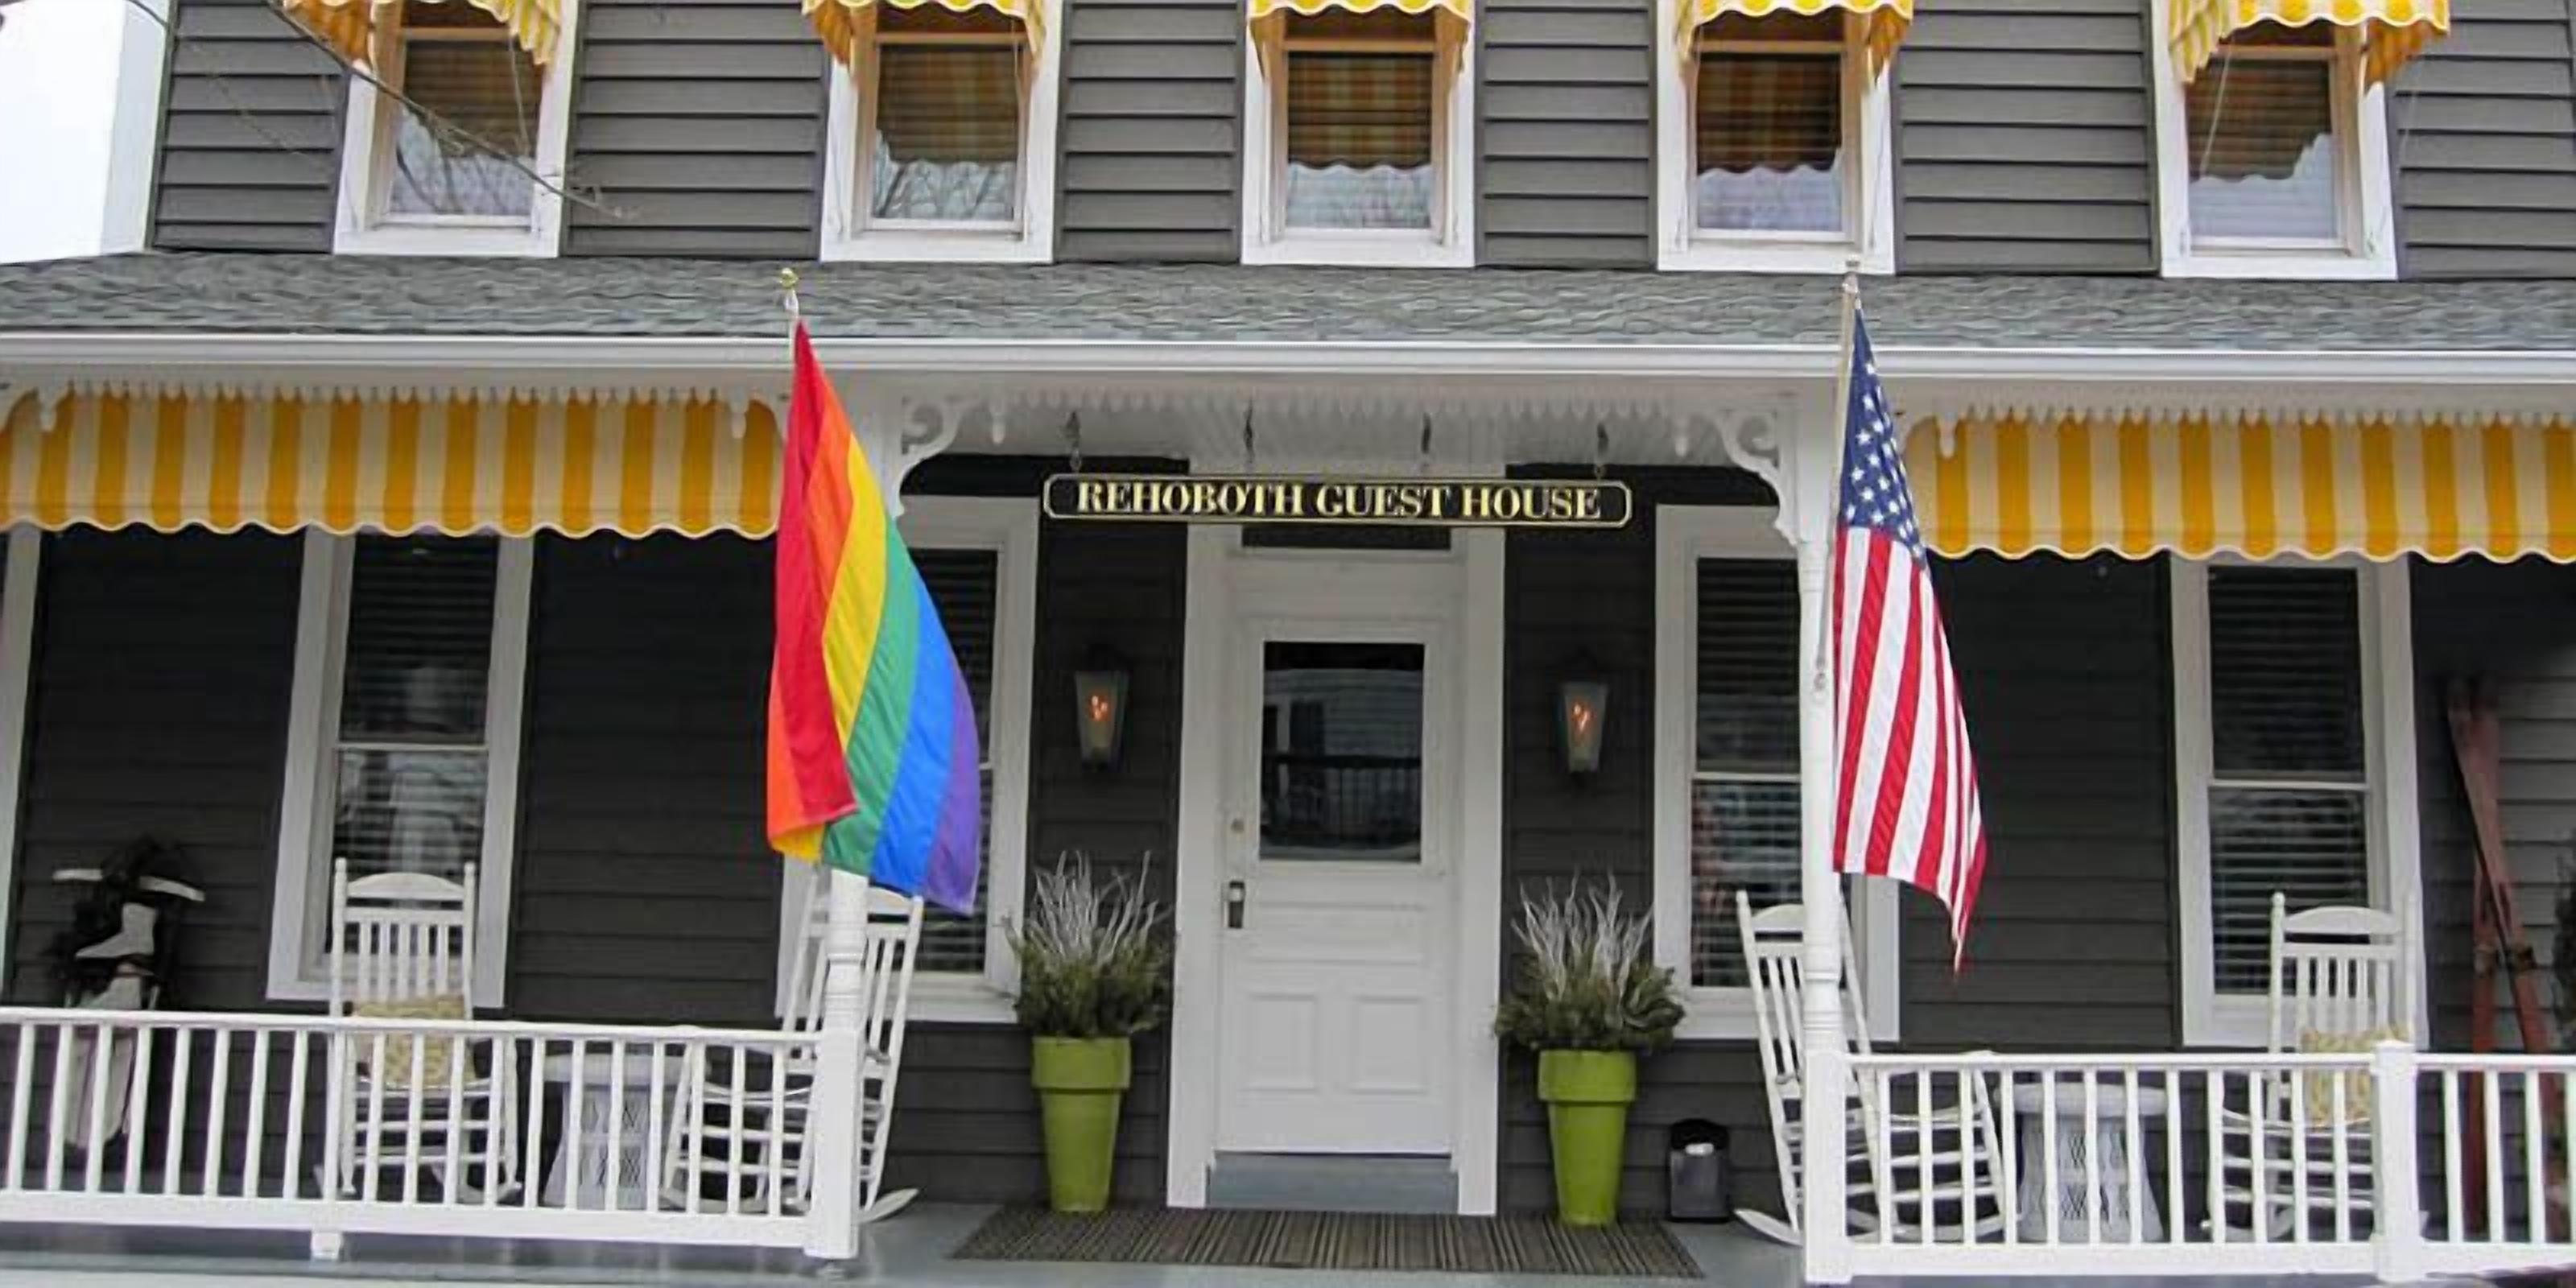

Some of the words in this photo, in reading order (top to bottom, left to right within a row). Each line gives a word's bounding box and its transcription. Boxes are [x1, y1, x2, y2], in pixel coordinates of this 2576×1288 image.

[1077, 481, 1303, 515] REHOBOTH
[1316, 485, 1449, 517] GUEST
[1462, 486, 1601, 519] HOUSE
